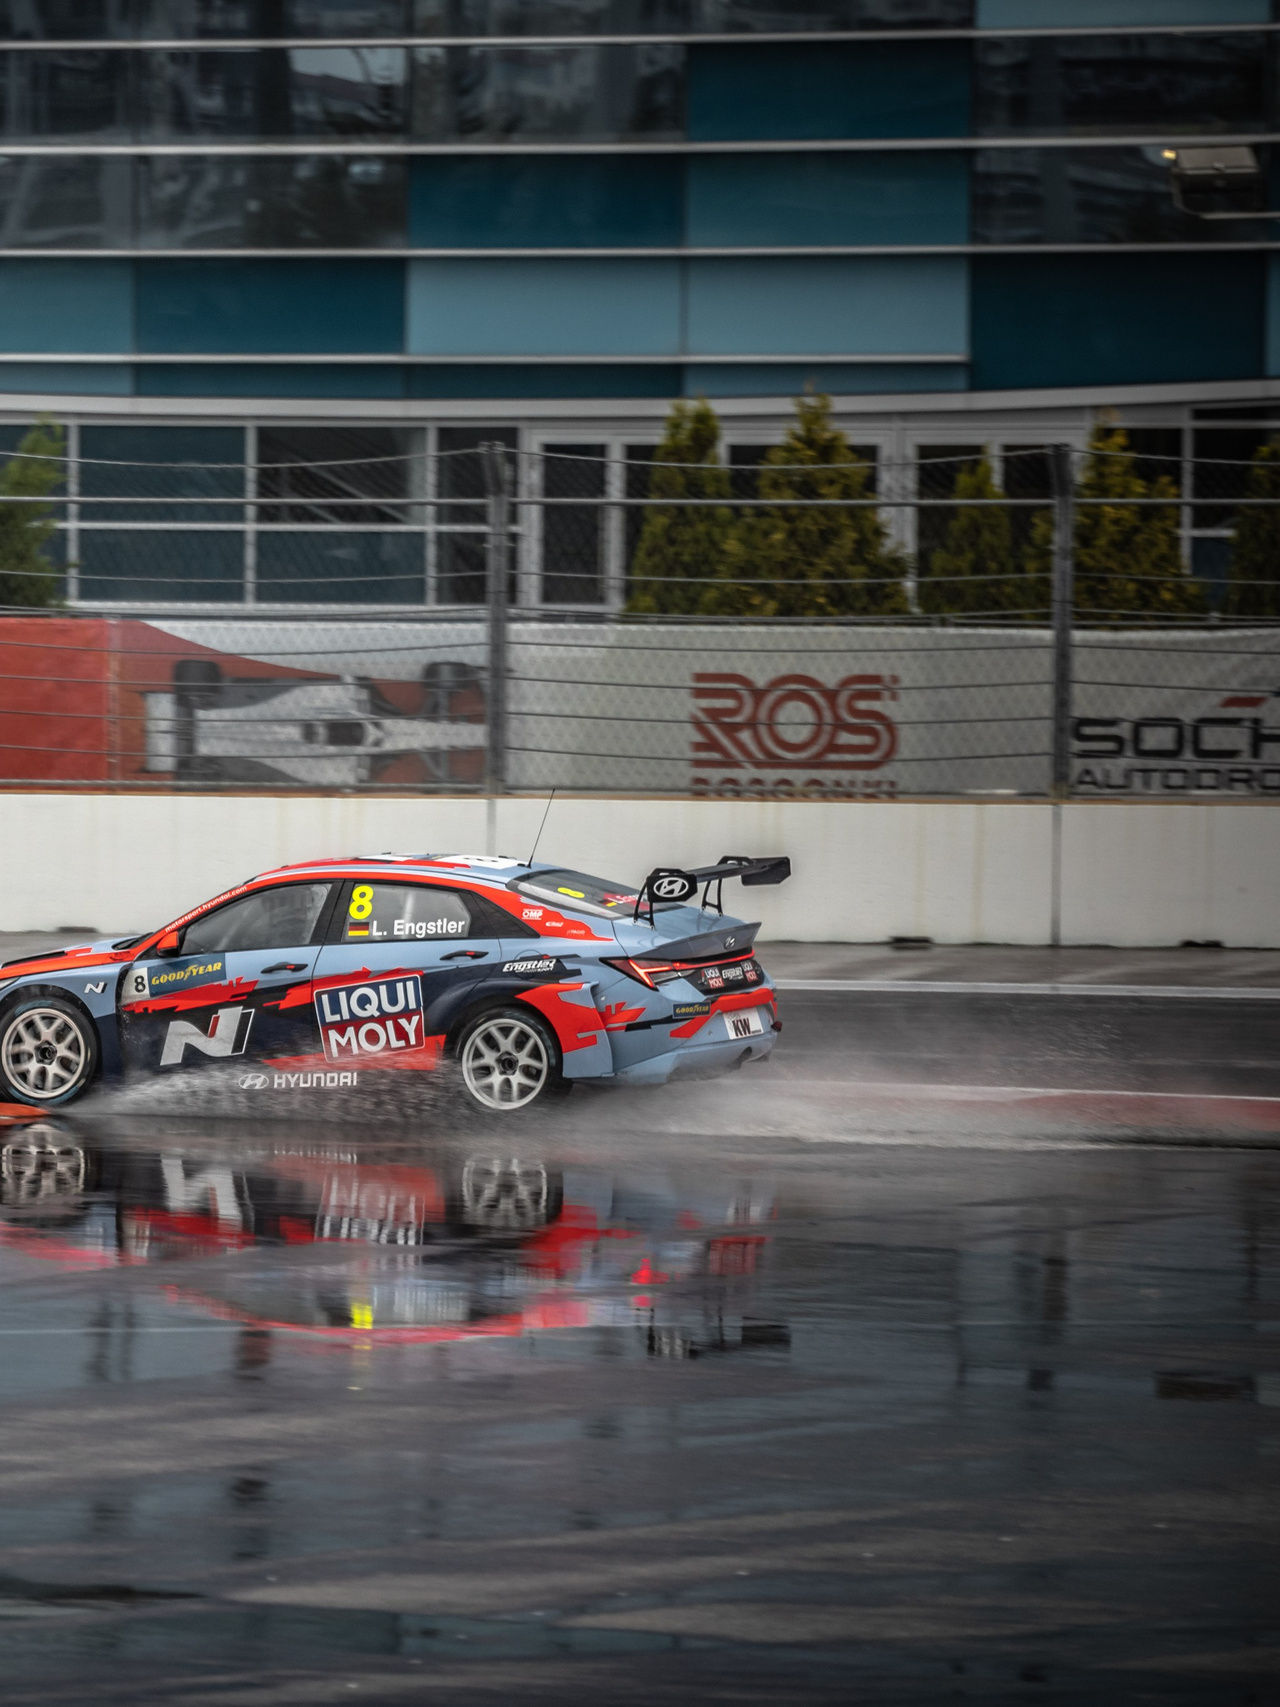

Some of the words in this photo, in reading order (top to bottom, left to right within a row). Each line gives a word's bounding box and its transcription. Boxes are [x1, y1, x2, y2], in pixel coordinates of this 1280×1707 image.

[690, 673, 900, 770] ROS
[165, 886, 248, 932] motorsport.hyundai.com
[349, 885, 374, 919] 8
[522, 909, 543, 920] OMP
[372, 920, 387, 936] L.
[393, 918, 466, 938] Engstler
[134, 975, 146, 993] 8
[151, 962, 222, 985] GOODYEAR
[321, 980, 417, 1023] LIQUI
[328, 1015, 420, 1057] MOLY
[732, 1018, 751, 1037] KW
[274, 1072, 357, 1088] HYUNDAI
